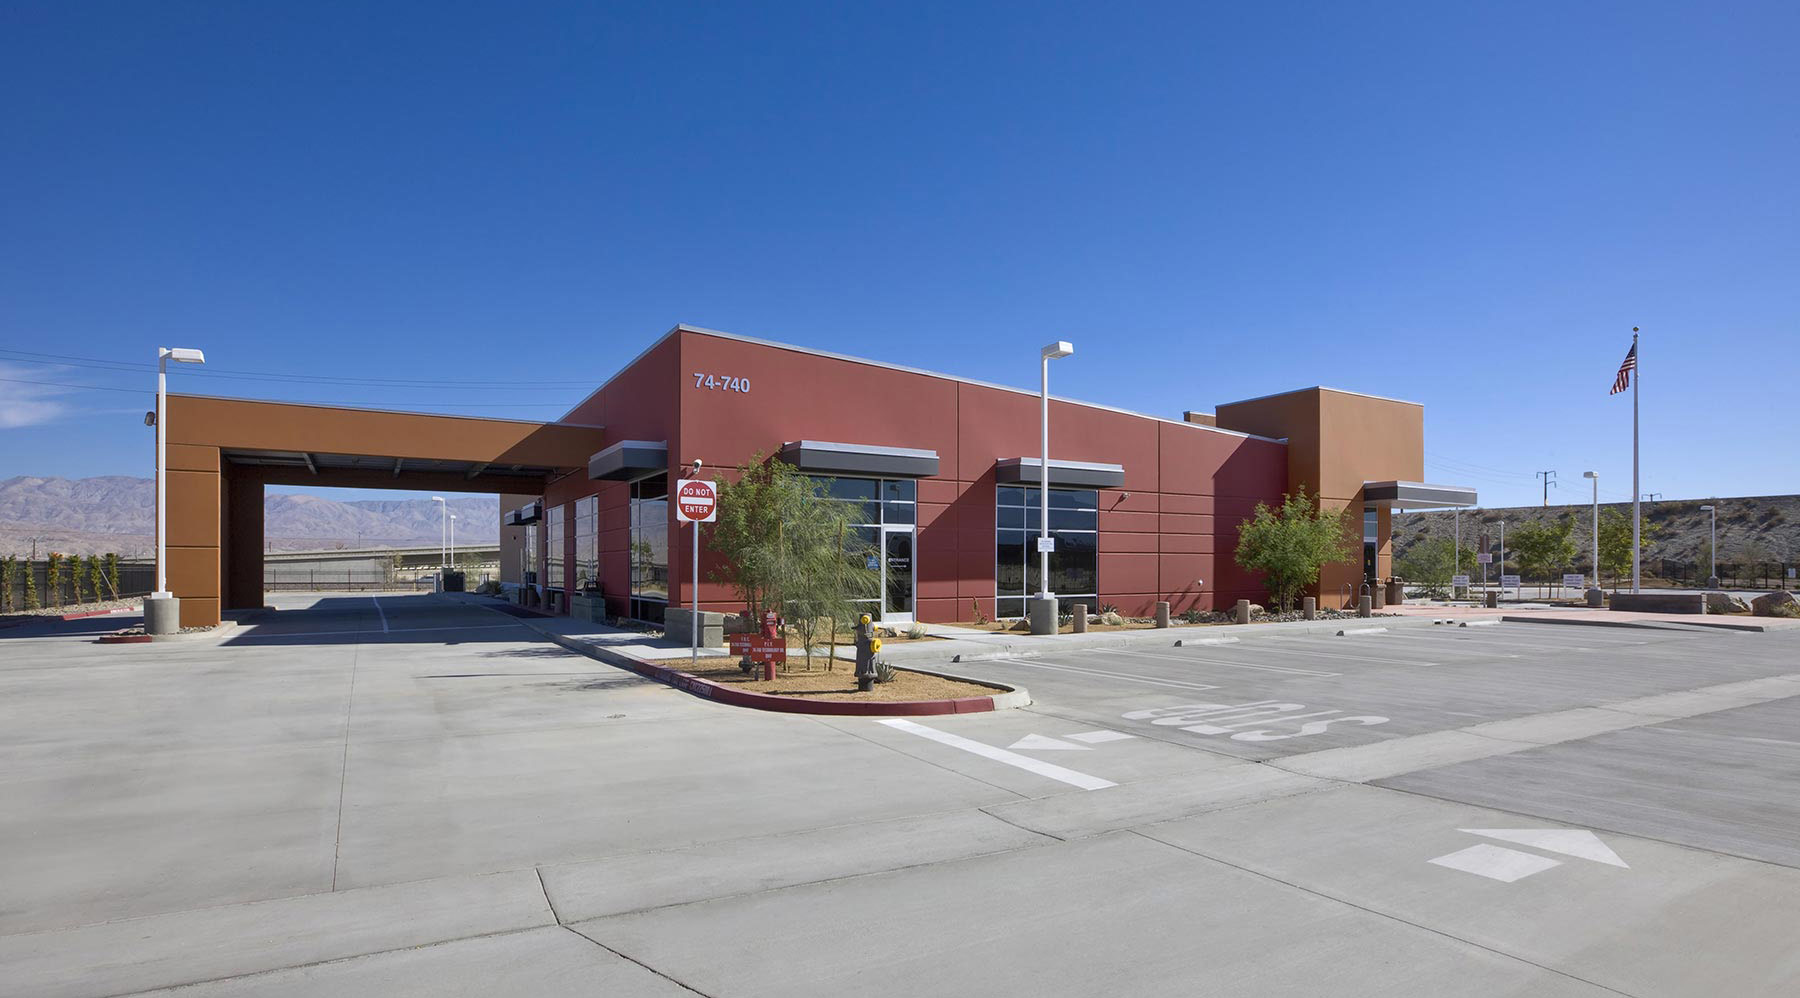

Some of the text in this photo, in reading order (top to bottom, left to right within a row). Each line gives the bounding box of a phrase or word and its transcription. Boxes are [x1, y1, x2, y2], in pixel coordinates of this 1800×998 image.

[693, 372, 751, 393] 74-740
[683, 487, 710, 496] DO NOT
[685, 505, 709, 514] ENTER
